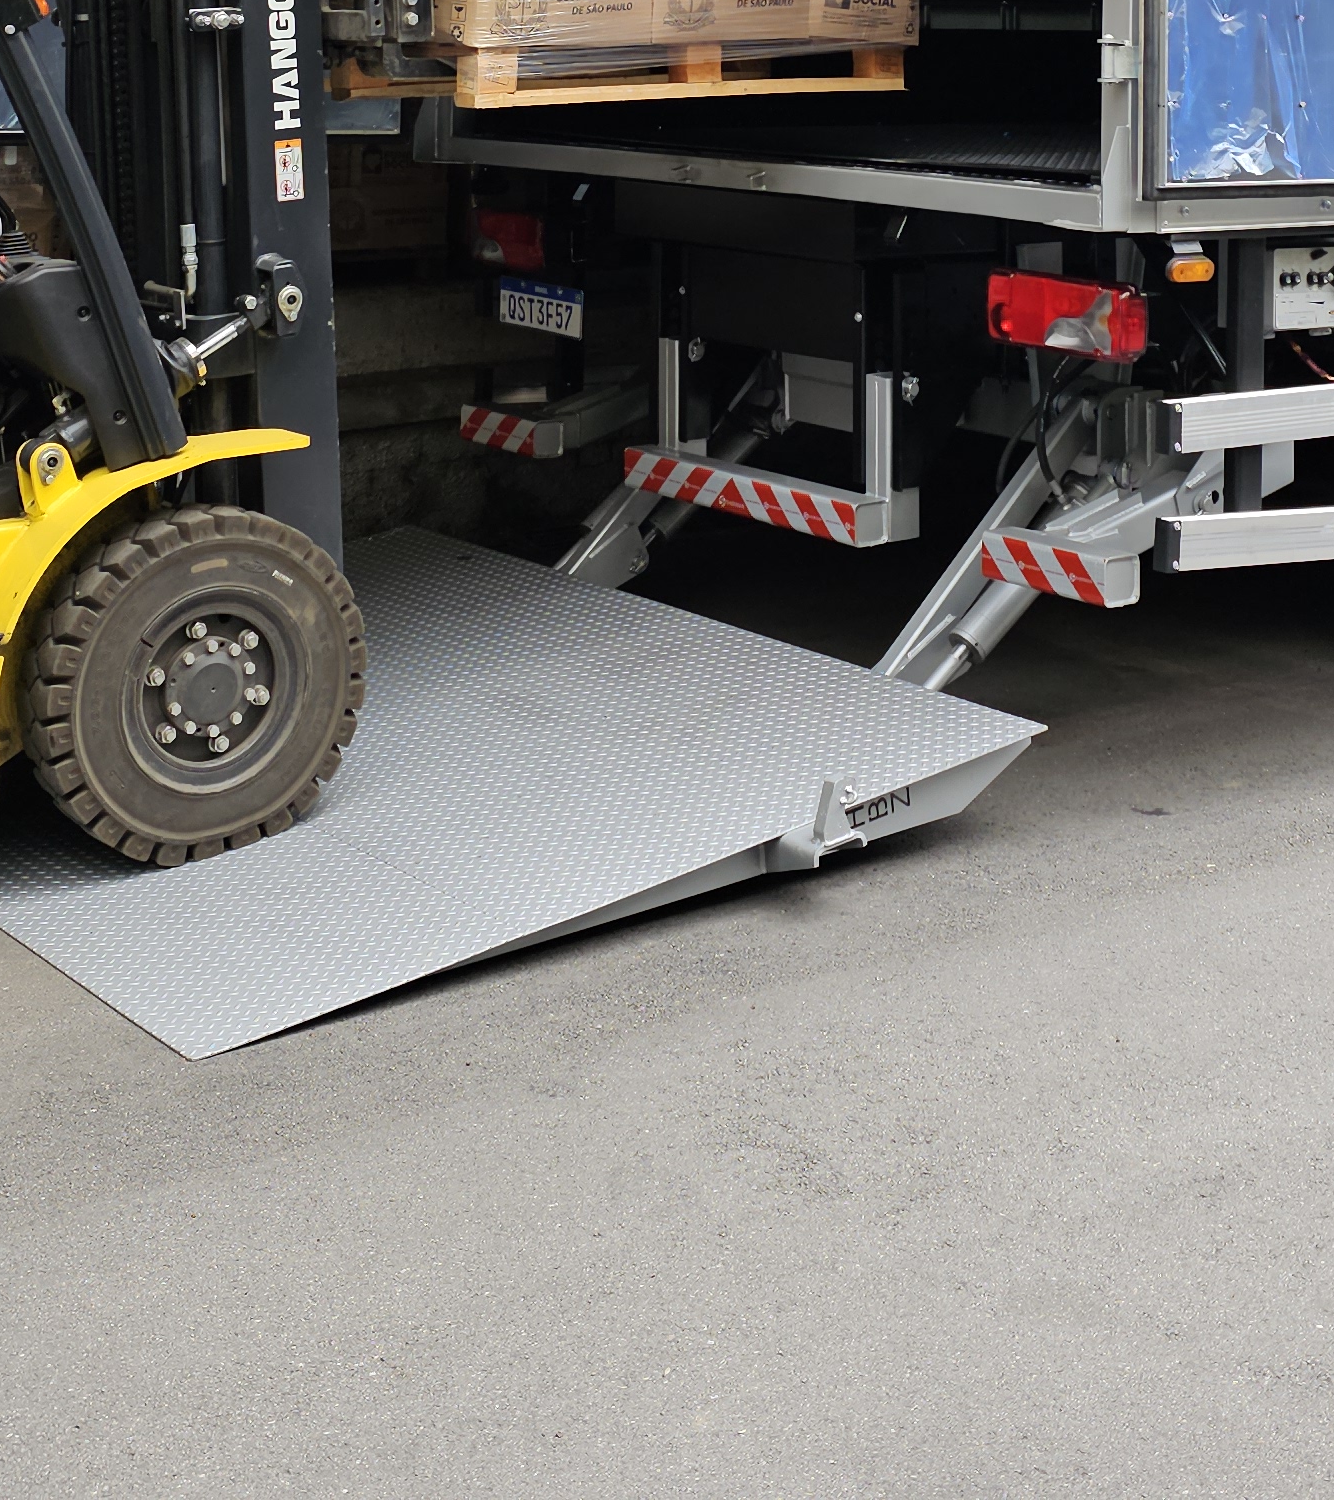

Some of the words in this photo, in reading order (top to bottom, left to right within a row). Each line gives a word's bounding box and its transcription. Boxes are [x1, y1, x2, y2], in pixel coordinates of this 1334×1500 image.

[572, 6, 583, 15] DE
[586, 3, 603, 14] SÃO
[606, 2, 633, 12] PAULO
[509, 294, 573, 330] QST3F57
